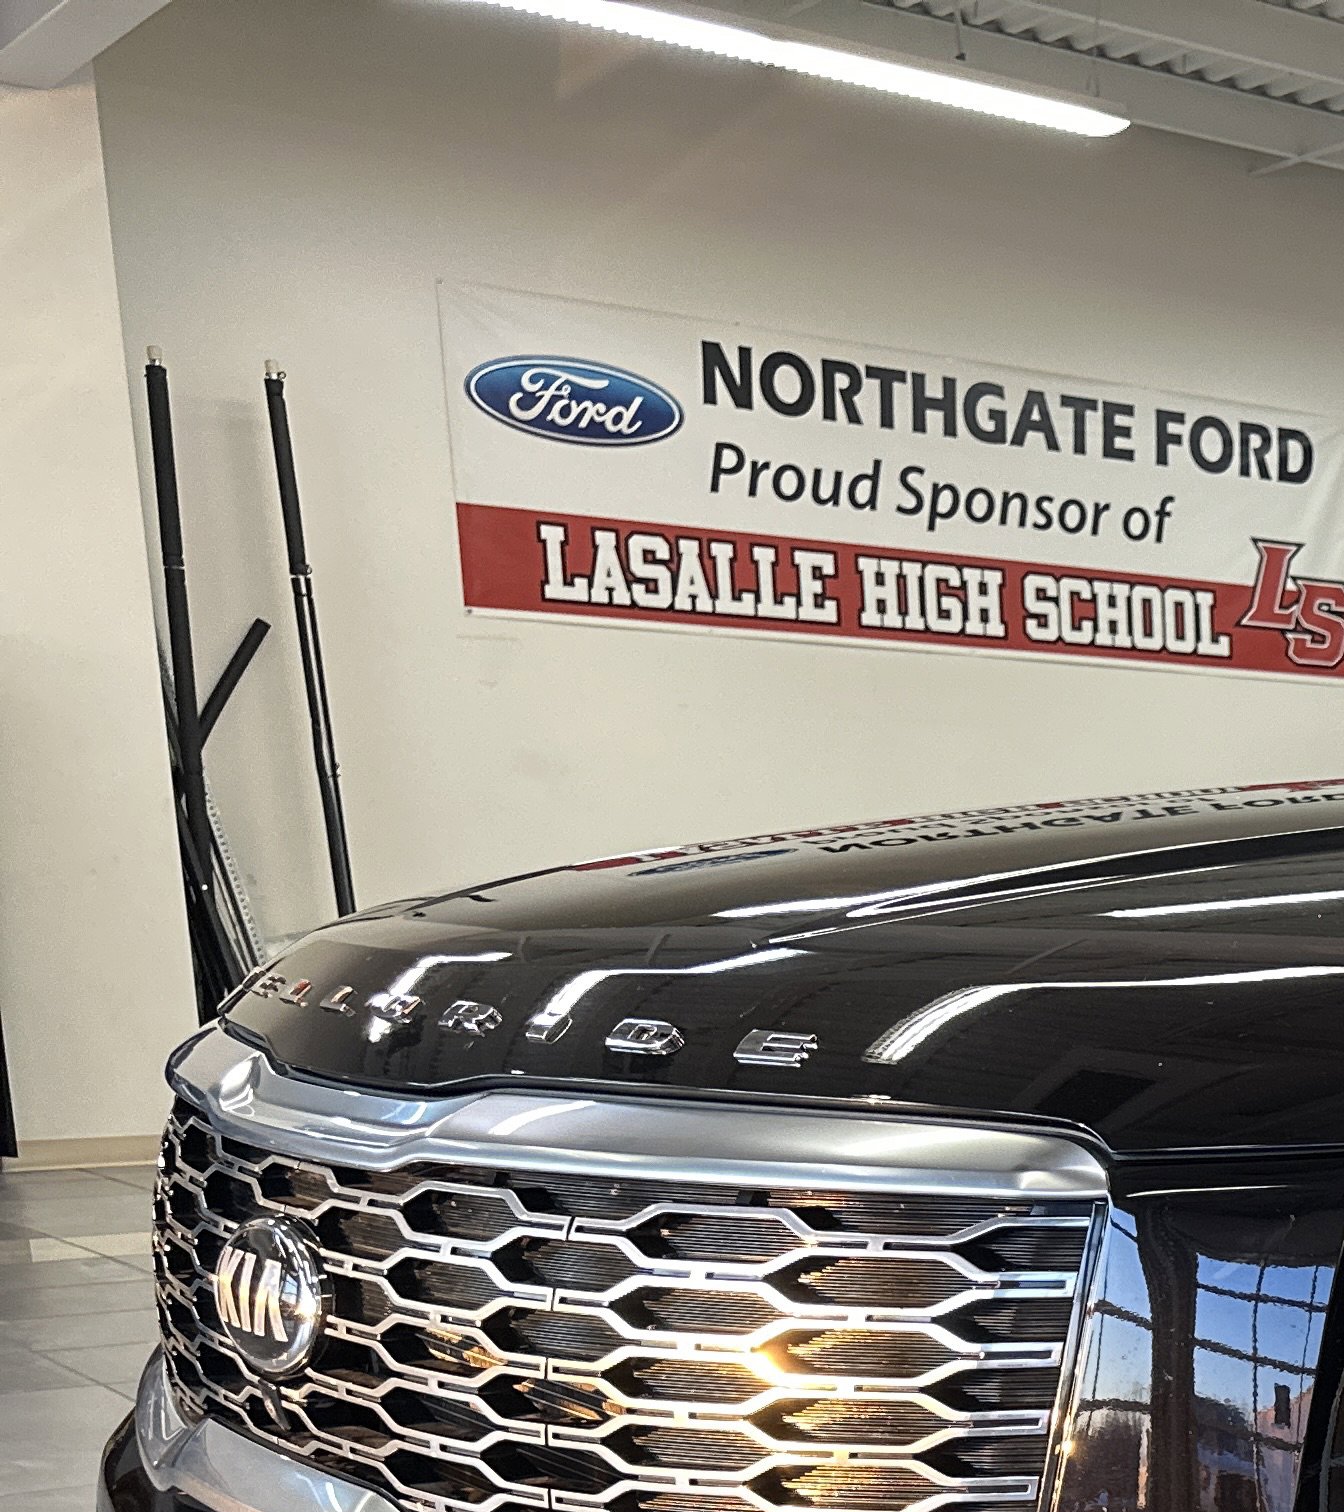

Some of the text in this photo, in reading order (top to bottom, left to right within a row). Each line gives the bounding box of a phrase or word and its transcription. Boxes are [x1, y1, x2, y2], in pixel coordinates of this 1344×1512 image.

[507, 366, 645, 436] Ford
[700, 338, 1317, 486] NORTHGATE FORD
[708, 440, 1177, 545] Proud Sponsor of
[538, 521, 1234, 659] LASALLE HIGH SCHOOL
[216, 1243, 290, 1343] KIA
